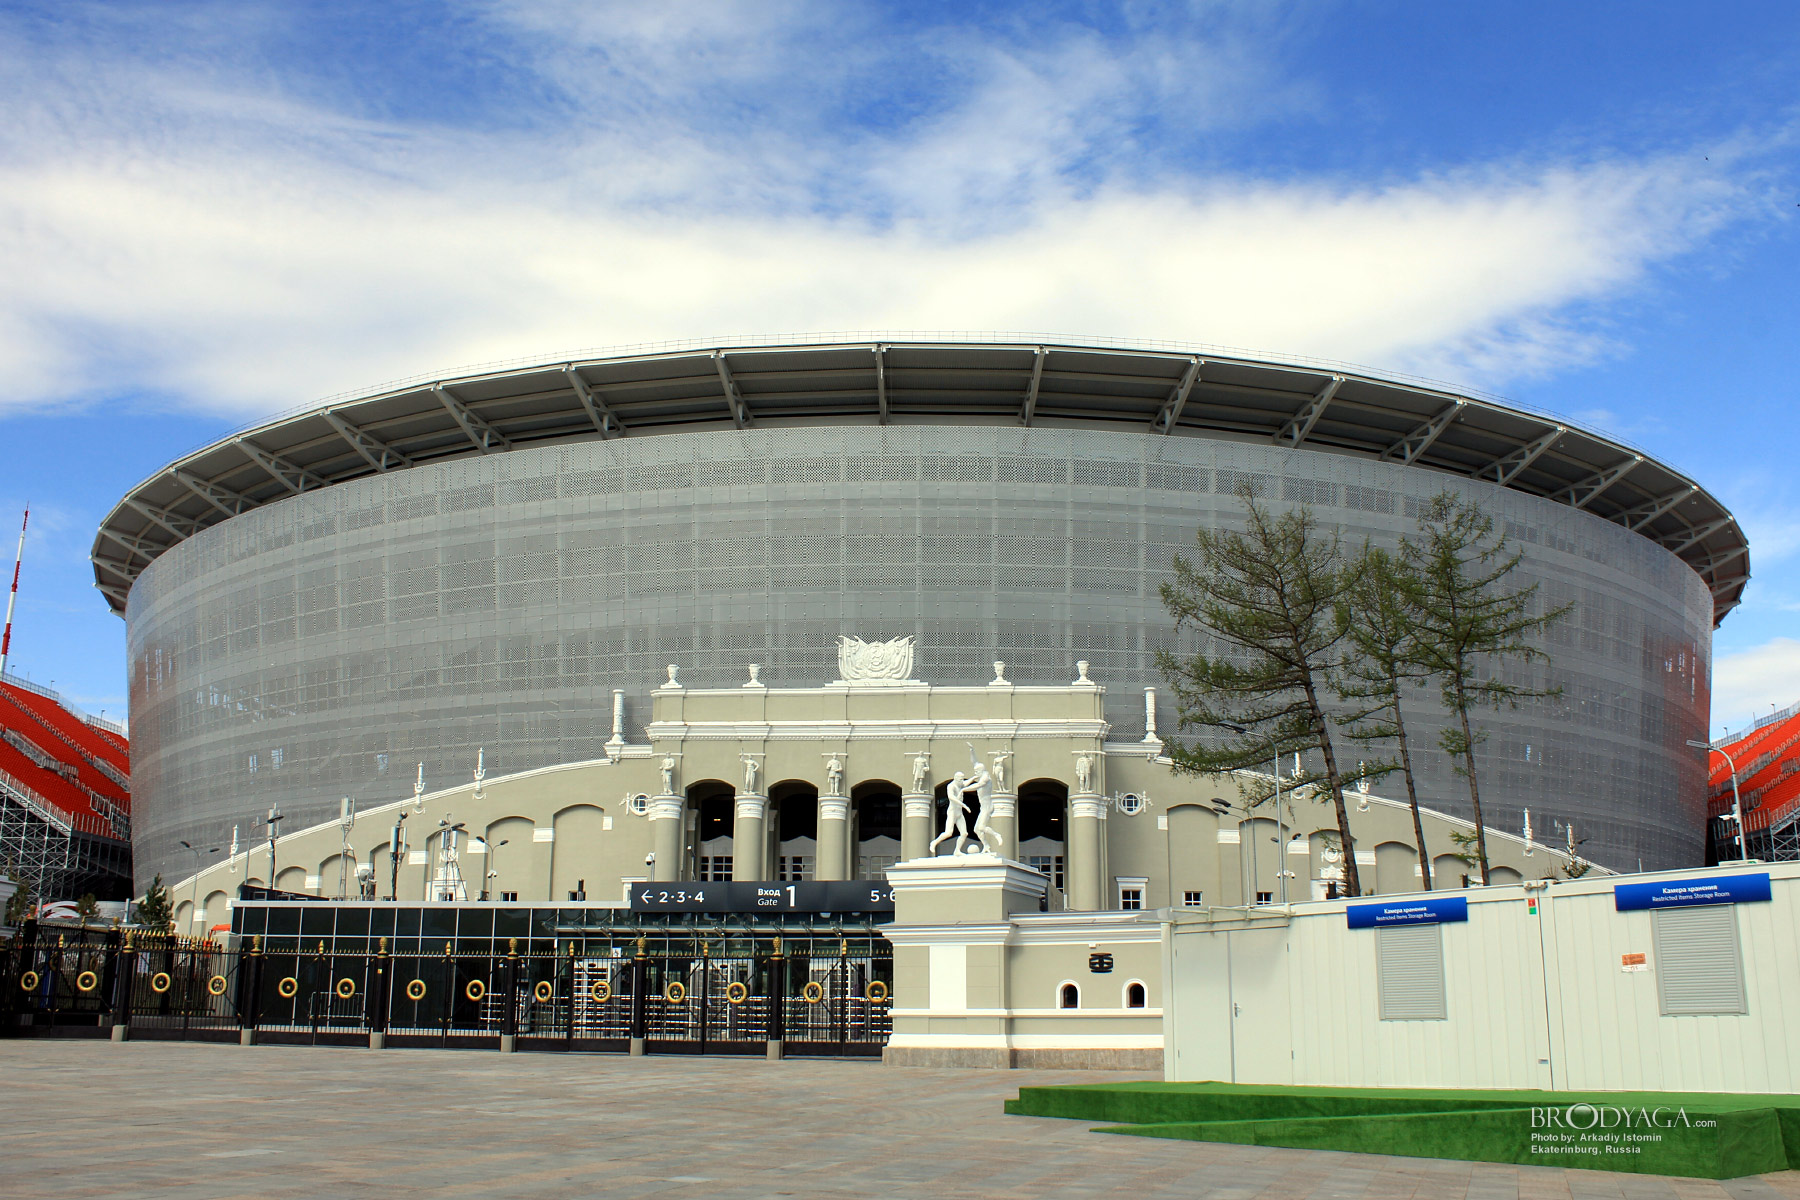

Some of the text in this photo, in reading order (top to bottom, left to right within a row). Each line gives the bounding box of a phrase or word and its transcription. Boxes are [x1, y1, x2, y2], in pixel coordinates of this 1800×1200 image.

[758, 888, 781, 898] Вход
[1687, 884, 1718, 893] хранения
[786, 885, 796, 907] 1
[757, 898, 778, 906] Gate
